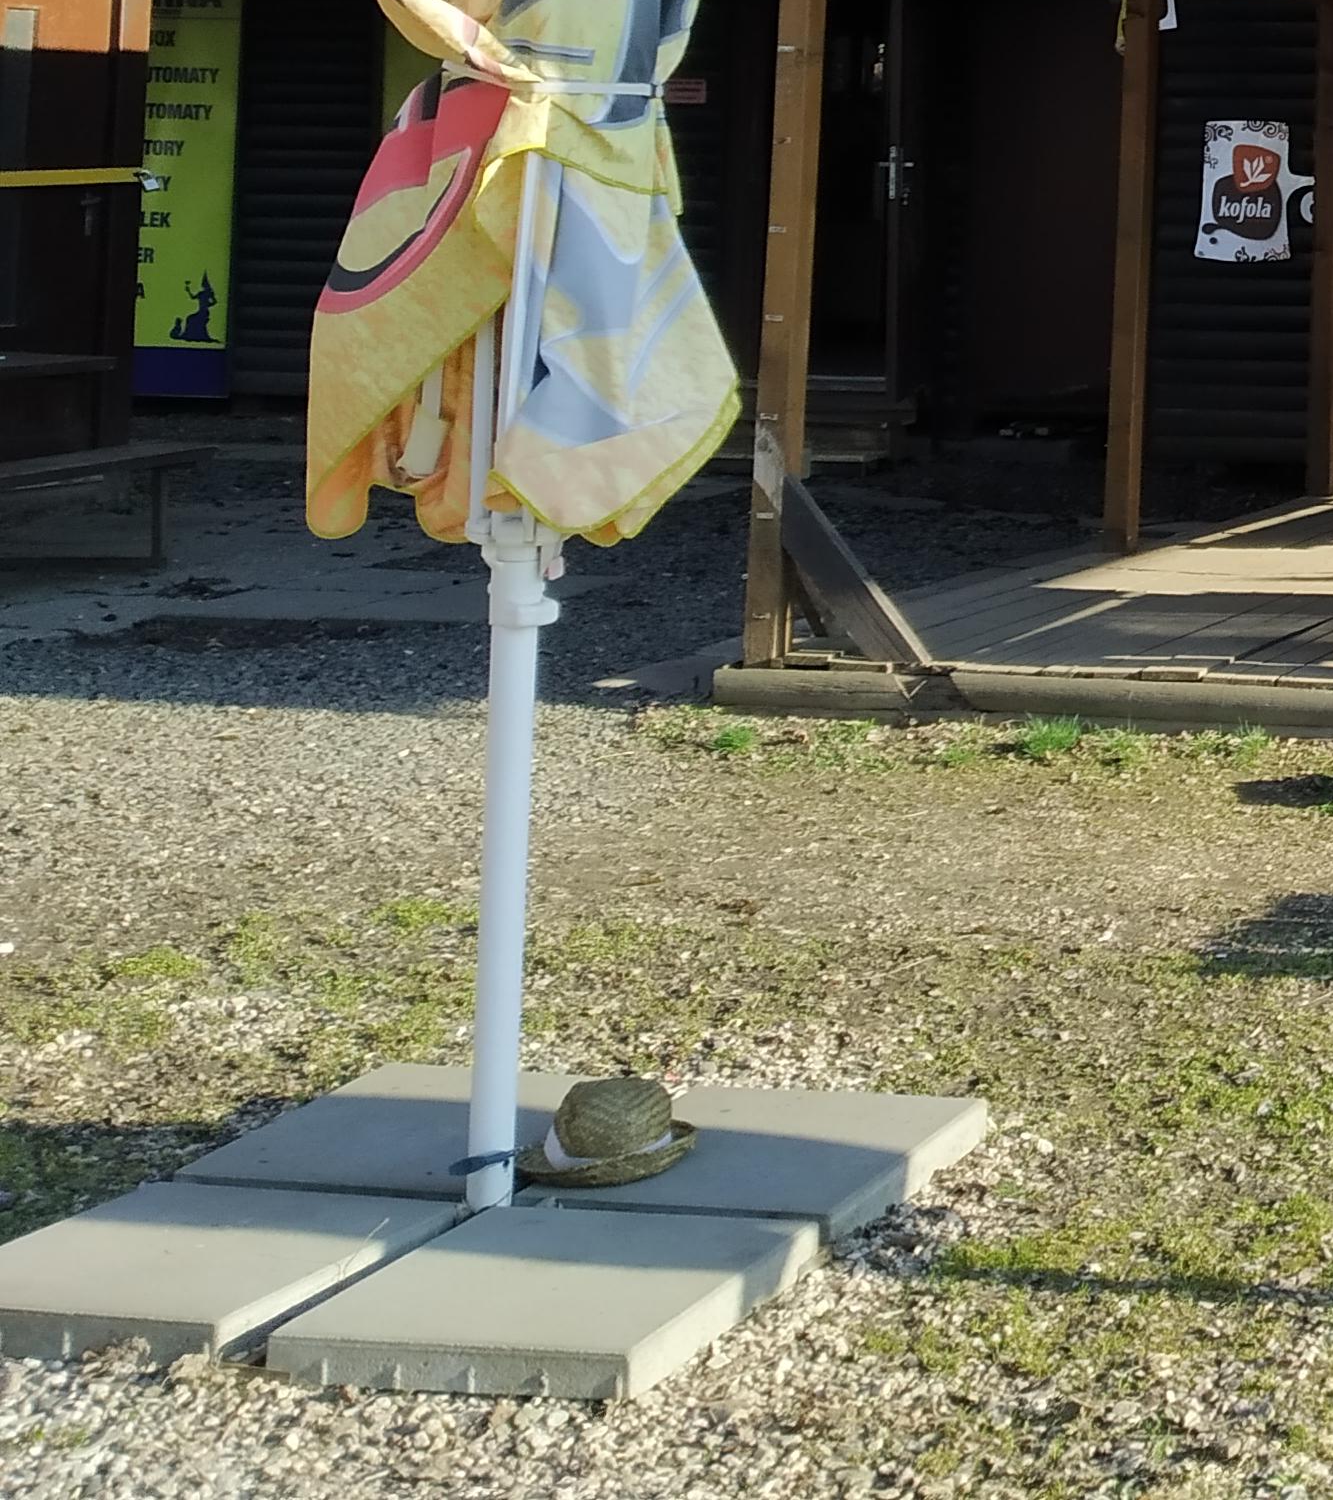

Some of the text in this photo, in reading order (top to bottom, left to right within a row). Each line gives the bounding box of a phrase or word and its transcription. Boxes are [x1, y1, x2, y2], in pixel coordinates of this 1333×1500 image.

[147, 102, 213, 121] TOMATY
[144, 139, 184, 156] TORY
[1218, 195, 1272, 224] kofola
